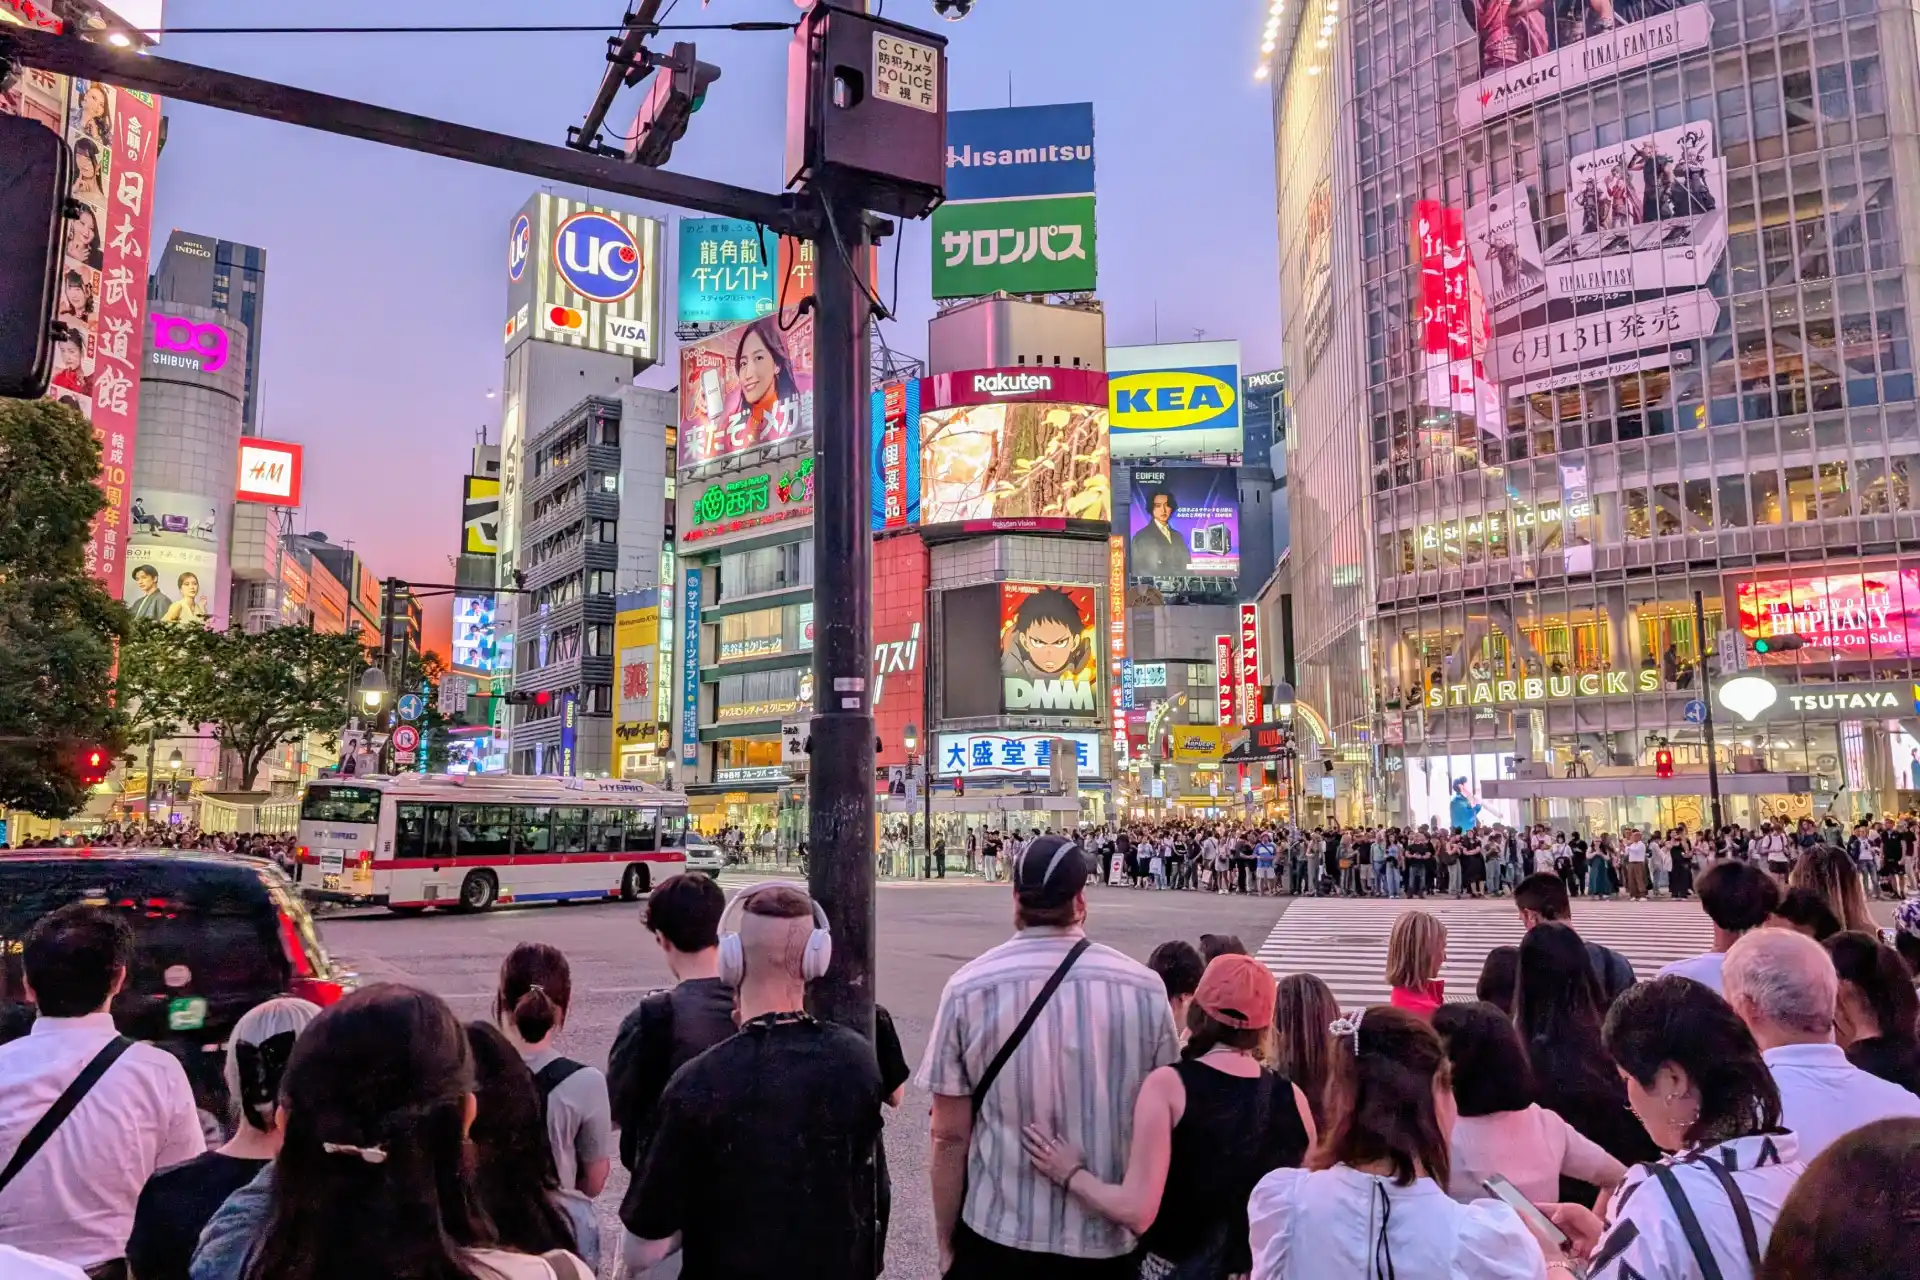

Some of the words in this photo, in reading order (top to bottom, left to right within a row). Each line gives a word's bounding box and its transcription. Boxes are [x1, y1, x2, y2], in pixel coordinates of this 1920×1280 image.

[878, 38, 932, 63] CCTV
[1583, 44, 1619, 72] FINAL
[878, 52, 932, 77] 防犯カメラ
[878, 65, 932, 91] POLICE
[1494, 65, 1560, 99] MAGIC
[878, 79, 932, 106] 警視庁
[946, 144, 1091, 168] Hisamitsu
[1586, 151, 1627, 172] MAGIC
[175, 245, 211, 258] INDIGO
[184, 241, 203, 249] HOTEL
[701, 239, 758, 265] 龍角散
[941, 225, 1086, 267] サロンパス
[692, 267, 768, 292] ダイレクト
[1559, 274, 1587, 292] FINAL
[1589, 267, 1633, 286] FANTASY
[95, 171, 144, 416] 日本武道館
[151, 313, 228, 372] 109
[610, 323, 646, 342] VISA
[1512, 306, 1680, 364] 6月13日発売
[153, 353, 199, 370] SHIBUYA
[974, 373, 1051, 391] Rakuten
[885, 391, 901, 518] 三千里薬品
[1136, 472, 1165, 480] EDIFIER
[727, 485, 768, 517] 西村
[1771, 607, 1889, 635] EPIPHANY
[686, 590, 698, 692] サマーフルーツギフト
[1243, 613, 1256, 675] カラオケ
[1844, 635, 1865, 645] On
[1870, 632, 1901, 643] Sale
[1136, 666, 1165, 675] れいわ
[1004, 678, 1095, 711] DMM
[1429, 669, 1659, 707] STARBUCKS
[1220, 685, 1231, 724] カラオ
[1790, 693, 1898, 711] TSUTAYA
[947, 740, 1088, 768] 大盛堂書店
[599, 784, 643, 792] HYBRID
[314, 831, 358, 840] HYBRID
